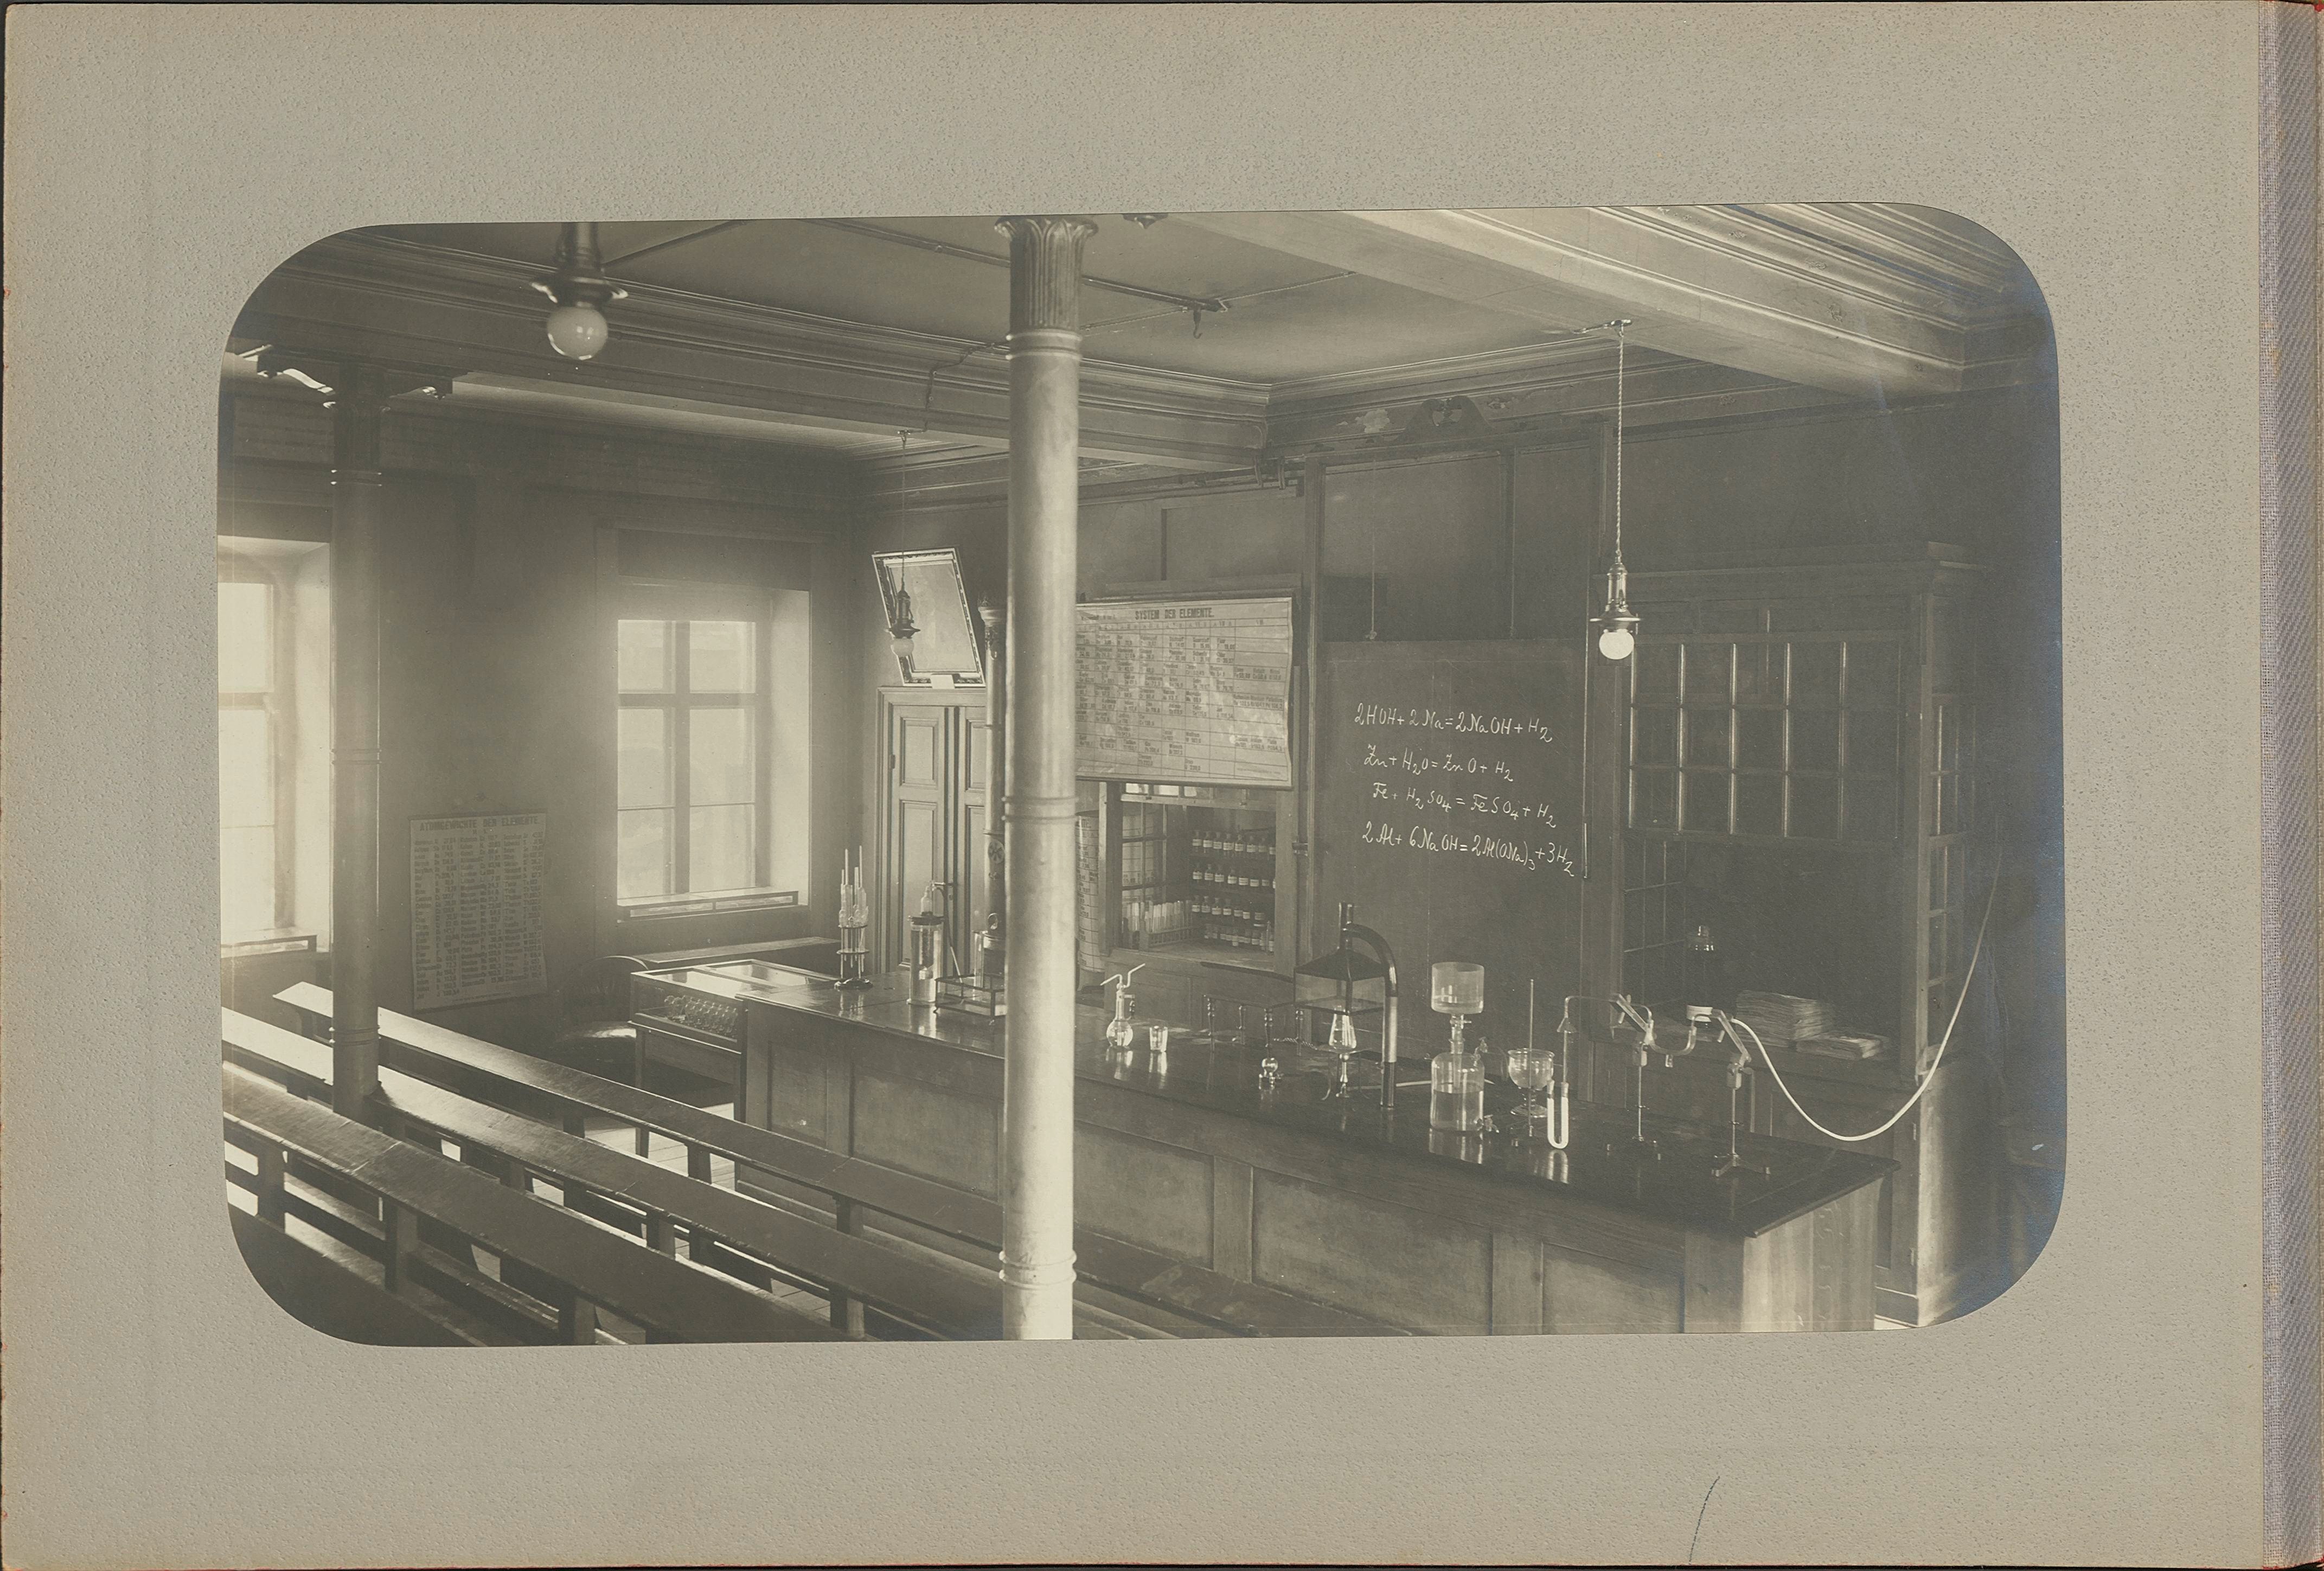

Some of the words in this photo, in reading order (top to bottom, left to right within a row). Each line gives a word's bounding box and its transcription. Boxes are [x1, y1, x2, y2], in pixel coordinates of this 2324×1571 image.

[1135, 610, 1160, 620] SYSTEM
[1164, 609, 1176, 618] DER
[483, 818, 497, 827] DER
